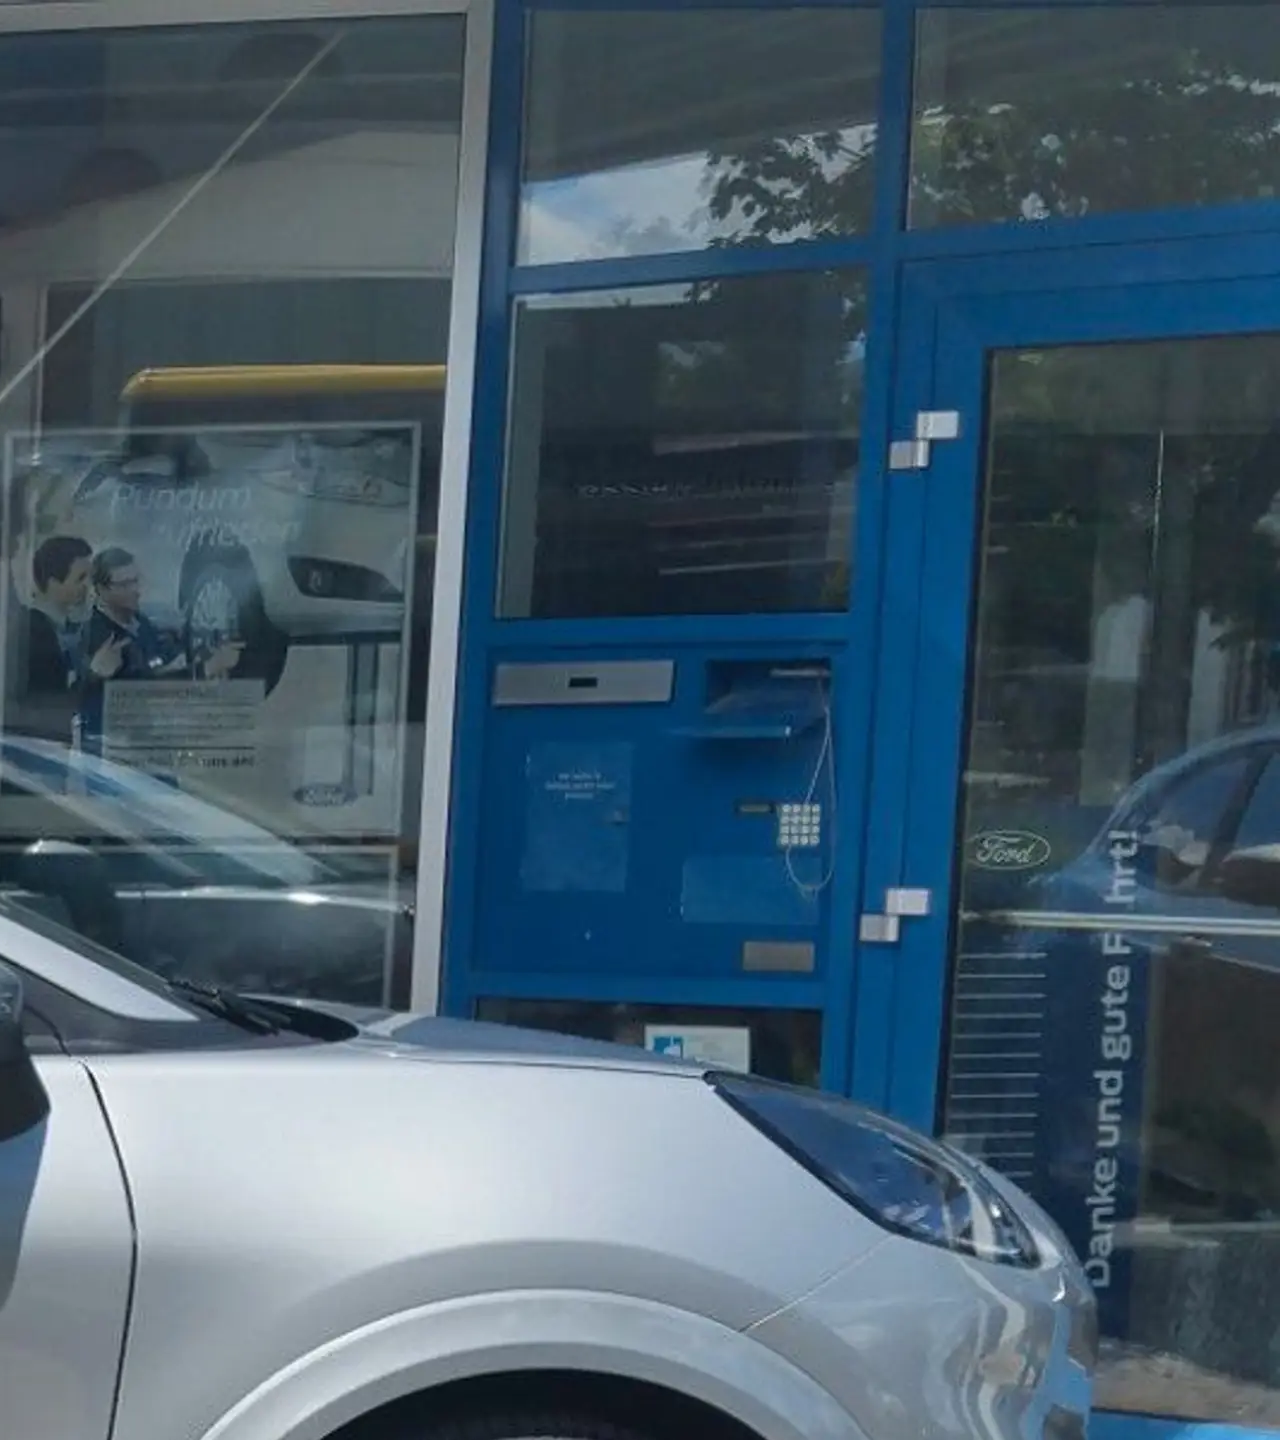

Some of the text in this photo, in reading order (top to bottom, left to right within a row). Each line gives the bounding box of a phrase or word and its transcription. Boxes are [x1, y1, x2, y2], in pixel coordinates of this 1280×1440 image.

[1084, 829, 1138, 1288] Danke und gute Fhrt!
